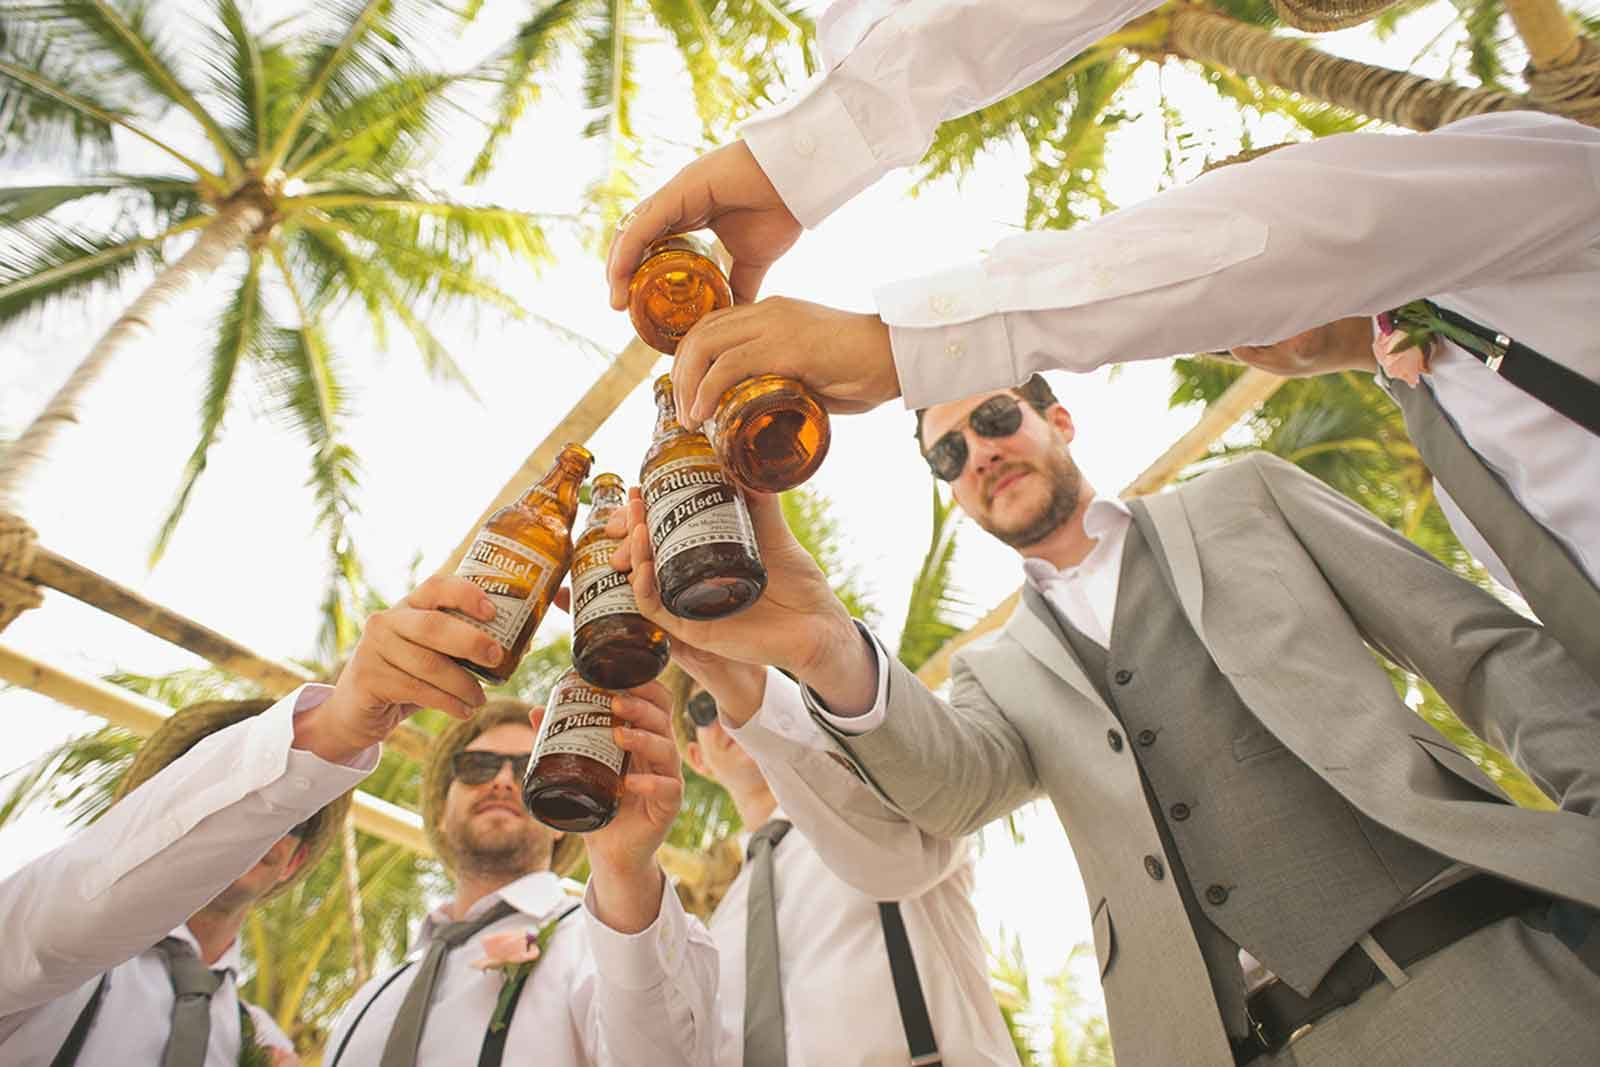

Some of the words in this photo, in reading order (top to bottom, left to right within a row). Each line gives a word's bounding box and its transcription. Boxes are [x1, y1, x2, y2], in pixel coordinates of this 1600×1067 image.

[653, 519, 674, 547] ale
[672, 490, 724, 524] Pilsen
[472, 540, 534, 579] Miguel
[595, 571, 627, 594] Pils
[564, 686, 611, 708] Migu
[564, 713, 612, 730] Pilsen
